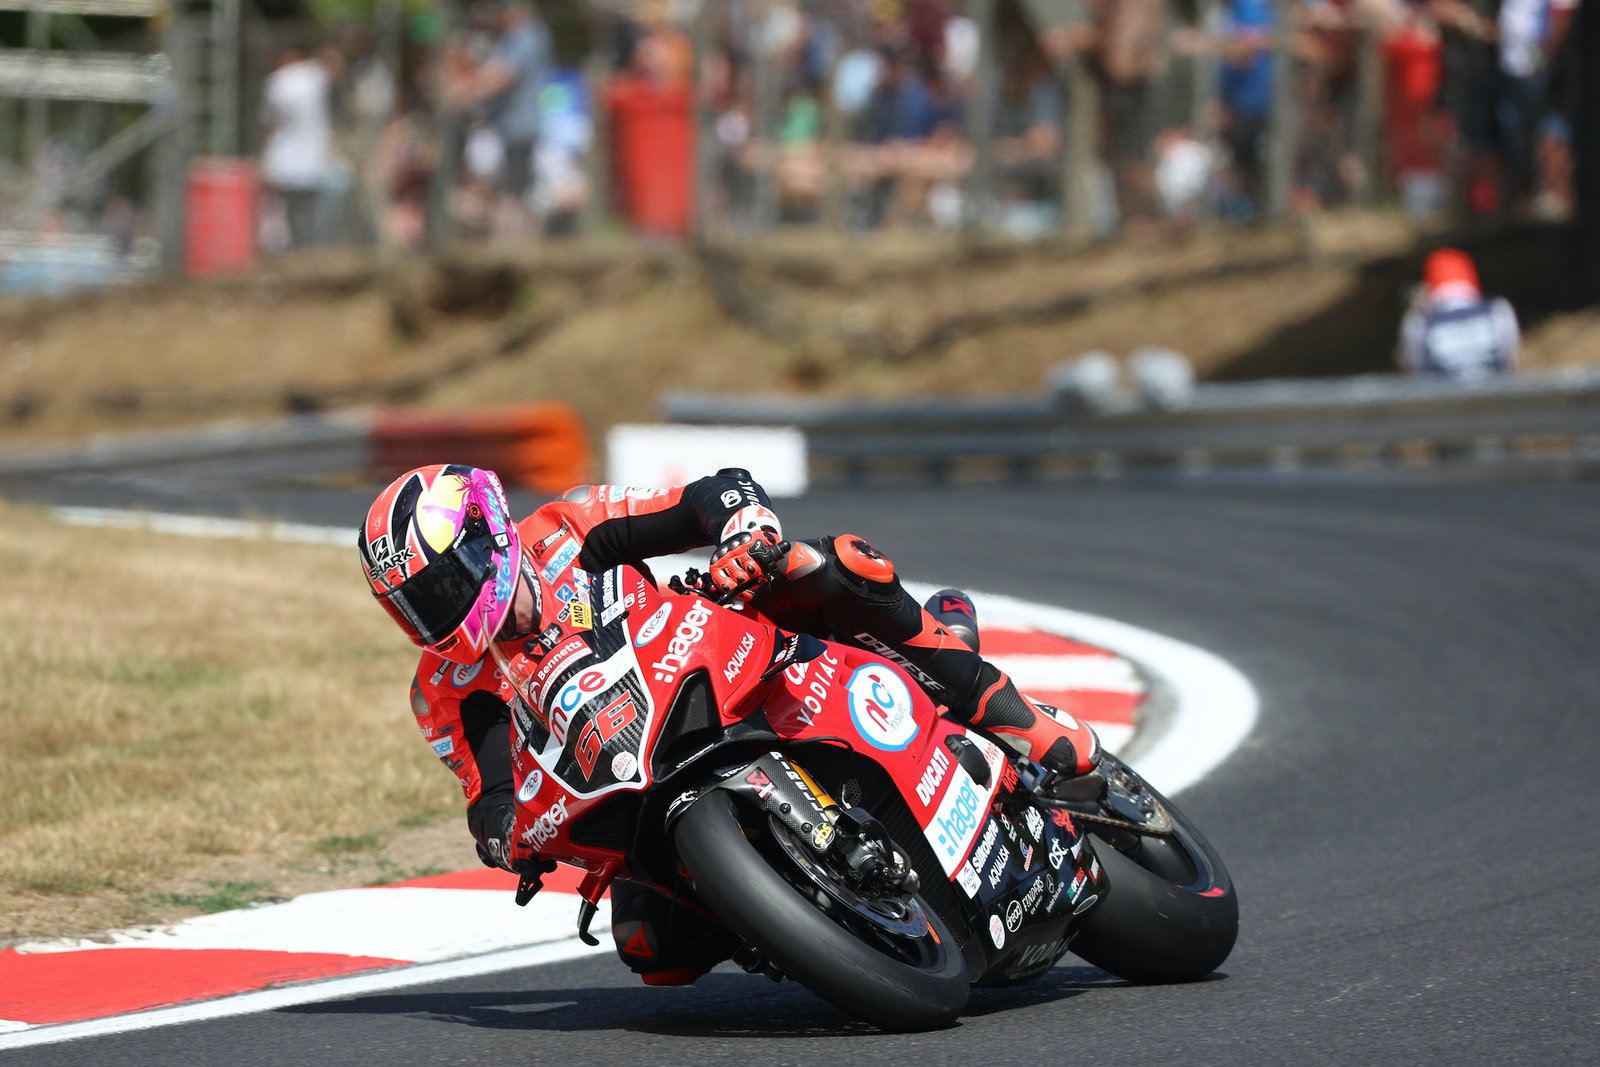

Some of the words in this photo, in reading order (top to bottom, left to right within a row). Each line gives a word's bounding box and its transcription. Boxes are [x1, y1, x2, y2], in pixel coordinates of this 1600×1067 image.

[368, 548, 415, 580] SHARK
[573, 605, 584, 625] AMD
[537, 640, 583, 681] Bennetts
[723, 632, 756, 684] AQUALISA
[854, 632, 946, 691] DAINESE
[550, 671, 606, 746] mce
[797, 650, 838, 726] VODIAC
[575, 690, 638, 782] 66
[769, 751, 829, 822] PIRELLI
[915, 746, 950, 807] DUCATI
[987, 844, 1011, 889] AQUALISA
